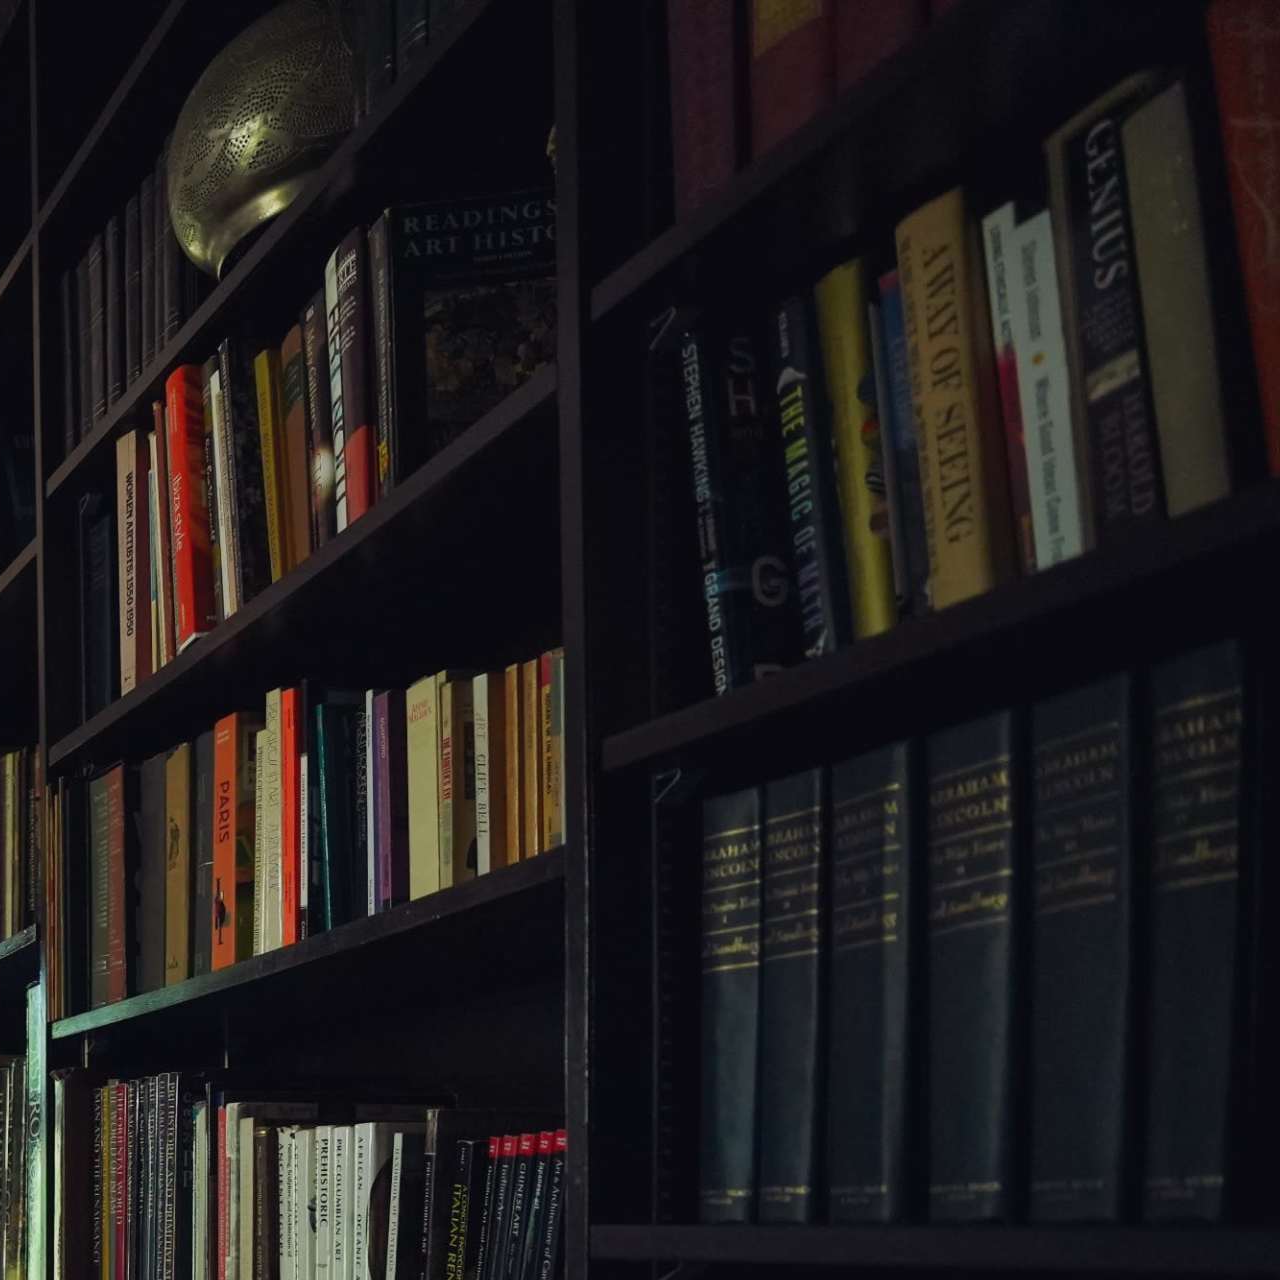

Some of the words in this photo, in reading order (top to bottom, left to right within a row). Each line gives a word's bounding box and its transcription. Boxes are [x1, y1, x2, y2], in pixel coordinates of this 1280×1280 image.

[403, 200, 557, 233] READINGS
[1086, 119, 1128, 289] GENIUS
[404, 235, 461, 259] ART
[681, 344, 703, 420] STEPHEN
[930, 349, 962, 391] OF
[779, 385, 805, 437] THE
[690, 423, 712, 502] HAWKING
[783, 438, 812, 521] MAGIC
[935, 402, 976, 545] SEEING
[125, 471, 134, 518] WOMEN
[175, 515, 185, 553] style
[792, 525, 817, 555] OF
[703, 570, 724, 632] GRAND
[798, 559, 826, 632] MATH
[218, 780, 231, 843] PARIS
[478, 802, 488, 838] BELL
[319, 1138, 329, 1228] PREHISTORIC
[335, 1138, 343, 1236] PRE-COLUMBIAN
[356, 1136, 364, 1191] AFRICAN
[513, 1162, 527, 1210] CHINESE
[355, 1213, 363, 1269] OCEANIC
[448, 1184, 462, 1247] ITALIAN
[511, 1211, 522, 1237] ART
[545, 1184, 561, 1244] Architecture
